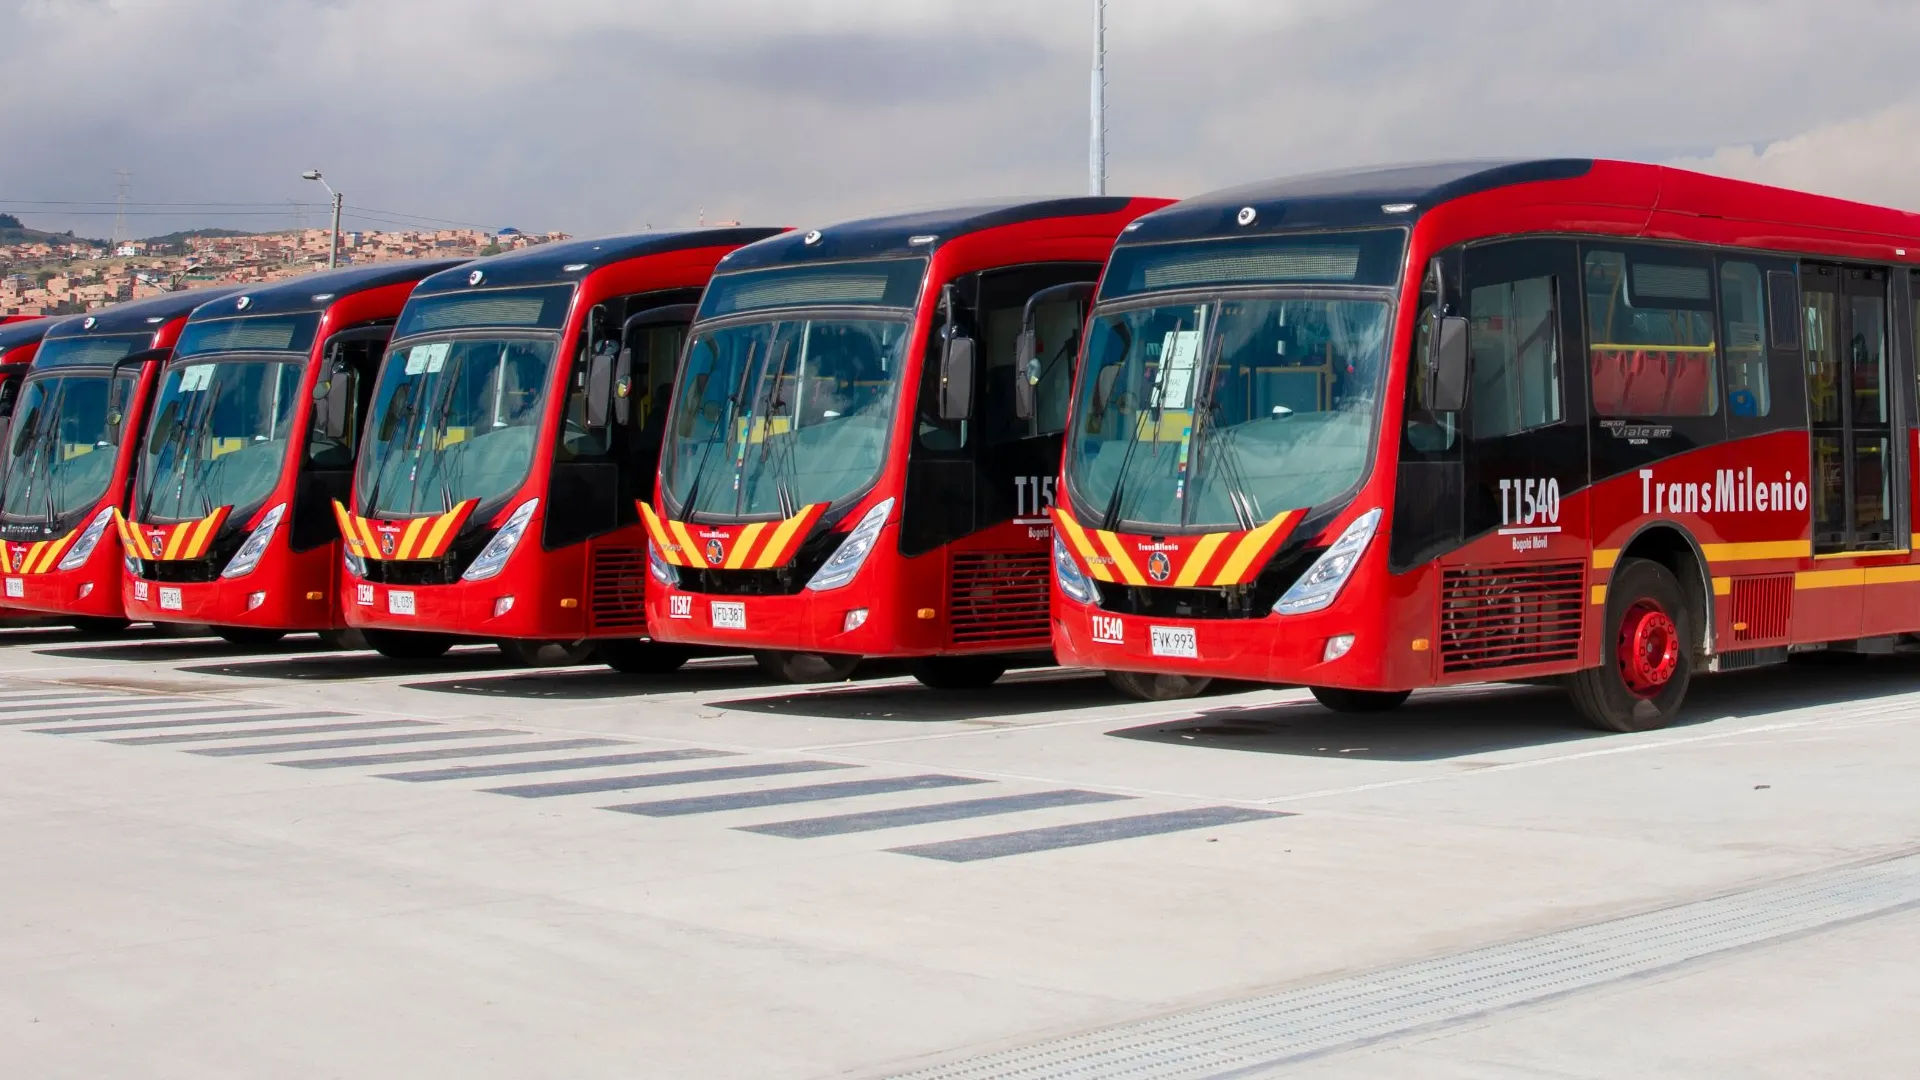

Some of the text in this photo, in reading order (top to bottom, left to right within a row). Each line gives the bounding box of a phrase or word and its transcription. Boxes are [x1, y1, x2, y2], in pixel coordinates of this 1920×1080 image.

[1611, 425, 1671, 437] Viale BRT
[1015, 476, 1059, 516] T15
[1639, 466, 1807, 514] TransMilenio
[1499, 477, 1559, 525] T1540
[1138, 543, 1178, 551] TransMilenio
[1512, 536, 1532, 552] Bogotá
[670, 596, 692, 614] T1587
[1092, 616, 1124, 640] T1540
